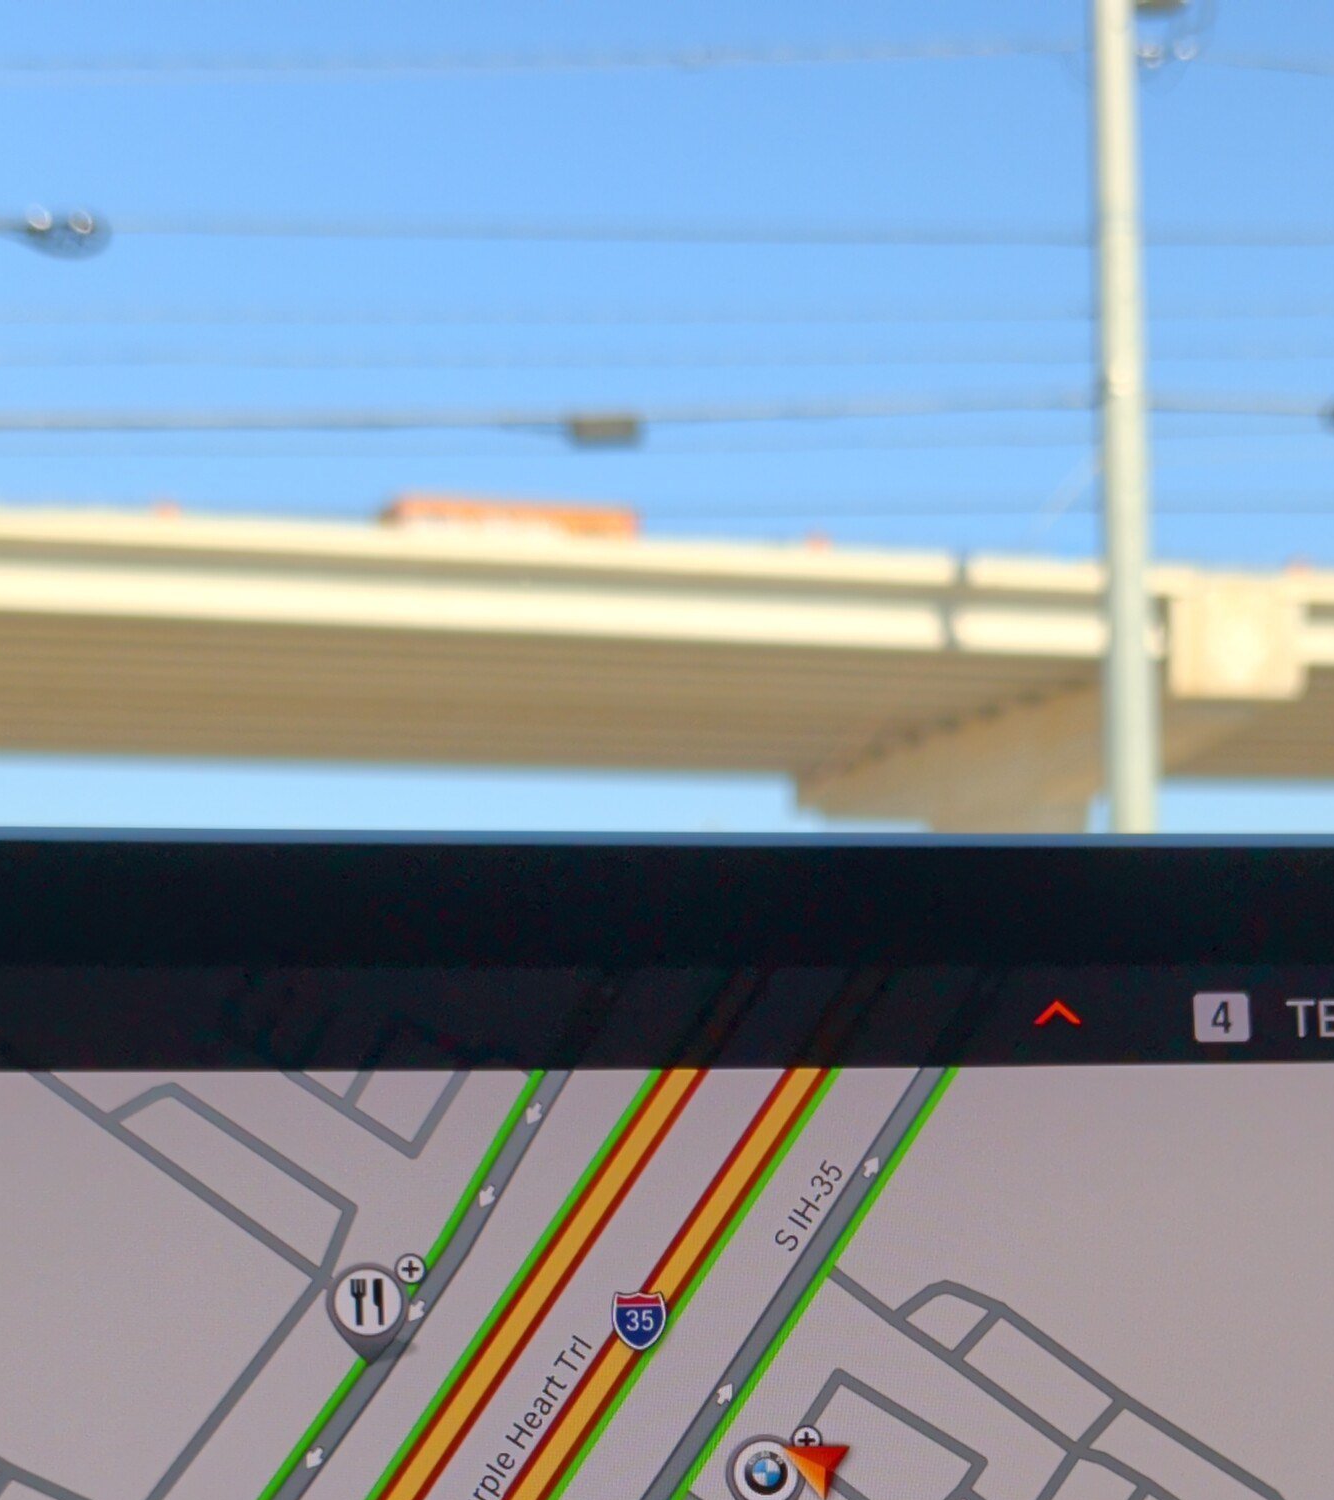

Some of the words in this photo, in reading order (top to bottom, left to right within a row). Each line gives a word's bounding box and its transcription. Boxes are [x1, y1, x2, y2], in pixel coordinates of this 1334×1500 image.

[774, 1229, 799, 1252] S
[787, 1159, 844, 1232] IH-35
[624, 1309, 655, 1332] 35
[505, 1373, 568, 1451] Heart
[554, 1333, 593, 1377] Trl
